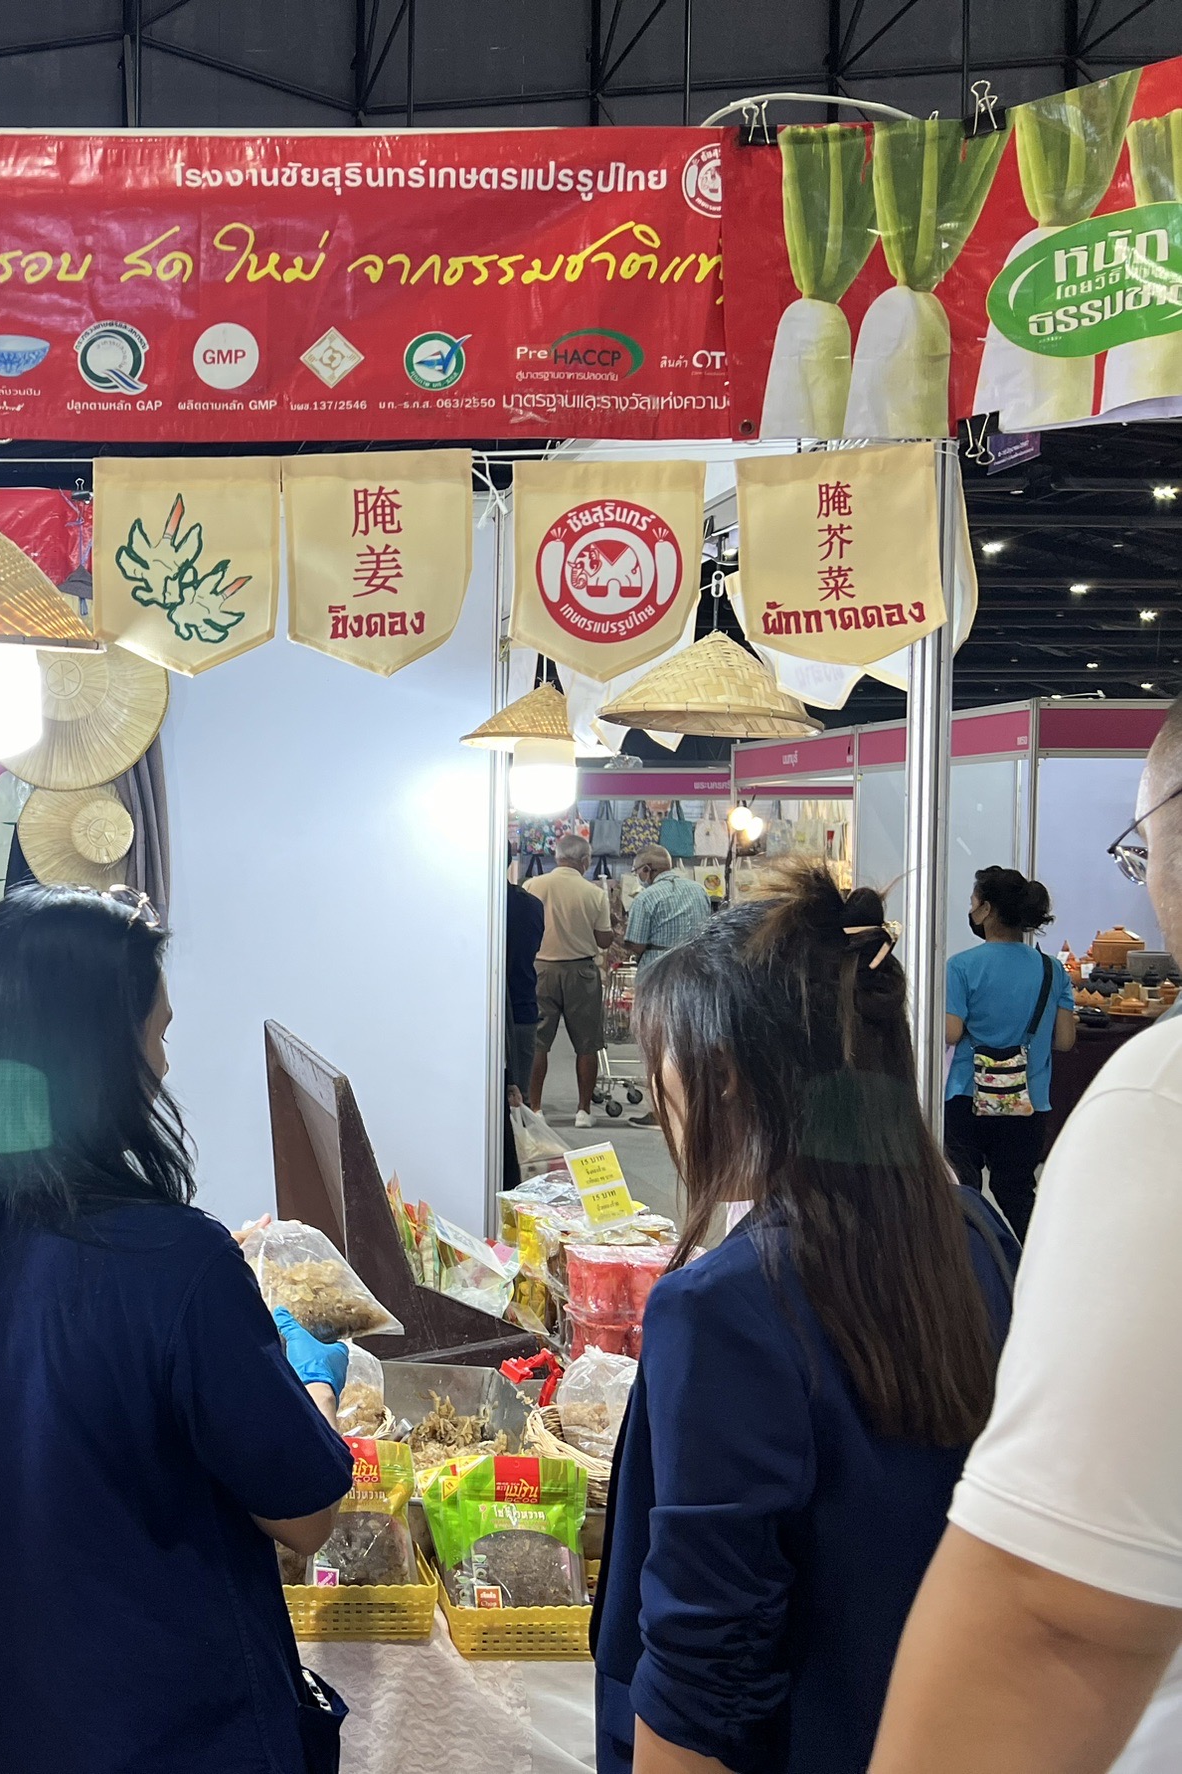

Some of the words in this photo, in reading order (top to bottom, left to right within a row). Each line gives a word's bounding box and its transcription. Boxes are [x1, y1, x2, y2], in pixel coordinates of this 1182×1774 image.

[175, 159, 668, 202] โรงงานชัยสุรินทร์เกษตรแปรรูปไทย
[119, 225, 195, 284] สด
[212, 221, 331, 285] ใหม่
[202, 349, 246, 365] GMP
[516, 346, 548, 360] Pre
[553, 348, 622, 367] HACCP
[659, 355, 689, 369] สินค้า
[66, 399, 132, 415] ปลูกตามหลัก
[135, 400, 163, 412] GAP
[177, 398, 245, 412] ผลิตตามหลัก
[248, 400, 278, 411] GMP
[436, 397, 496, 409] 063/2550
[502, 392, 730, 413] มาตรฐานและรางวัลแห่งความ
[565, 500, 658, 534] ชัยสุรินทร์
[350, 484, 405, 599] 腌姜
[815, 480, 856, 602] 腌芥菜
[327, 604, 426, 641] ขิงดอง
[558, 602, 658, 635] เกษตรแปรรูปไทย
[760, 601, 927, 636] ผักกาดดอง
